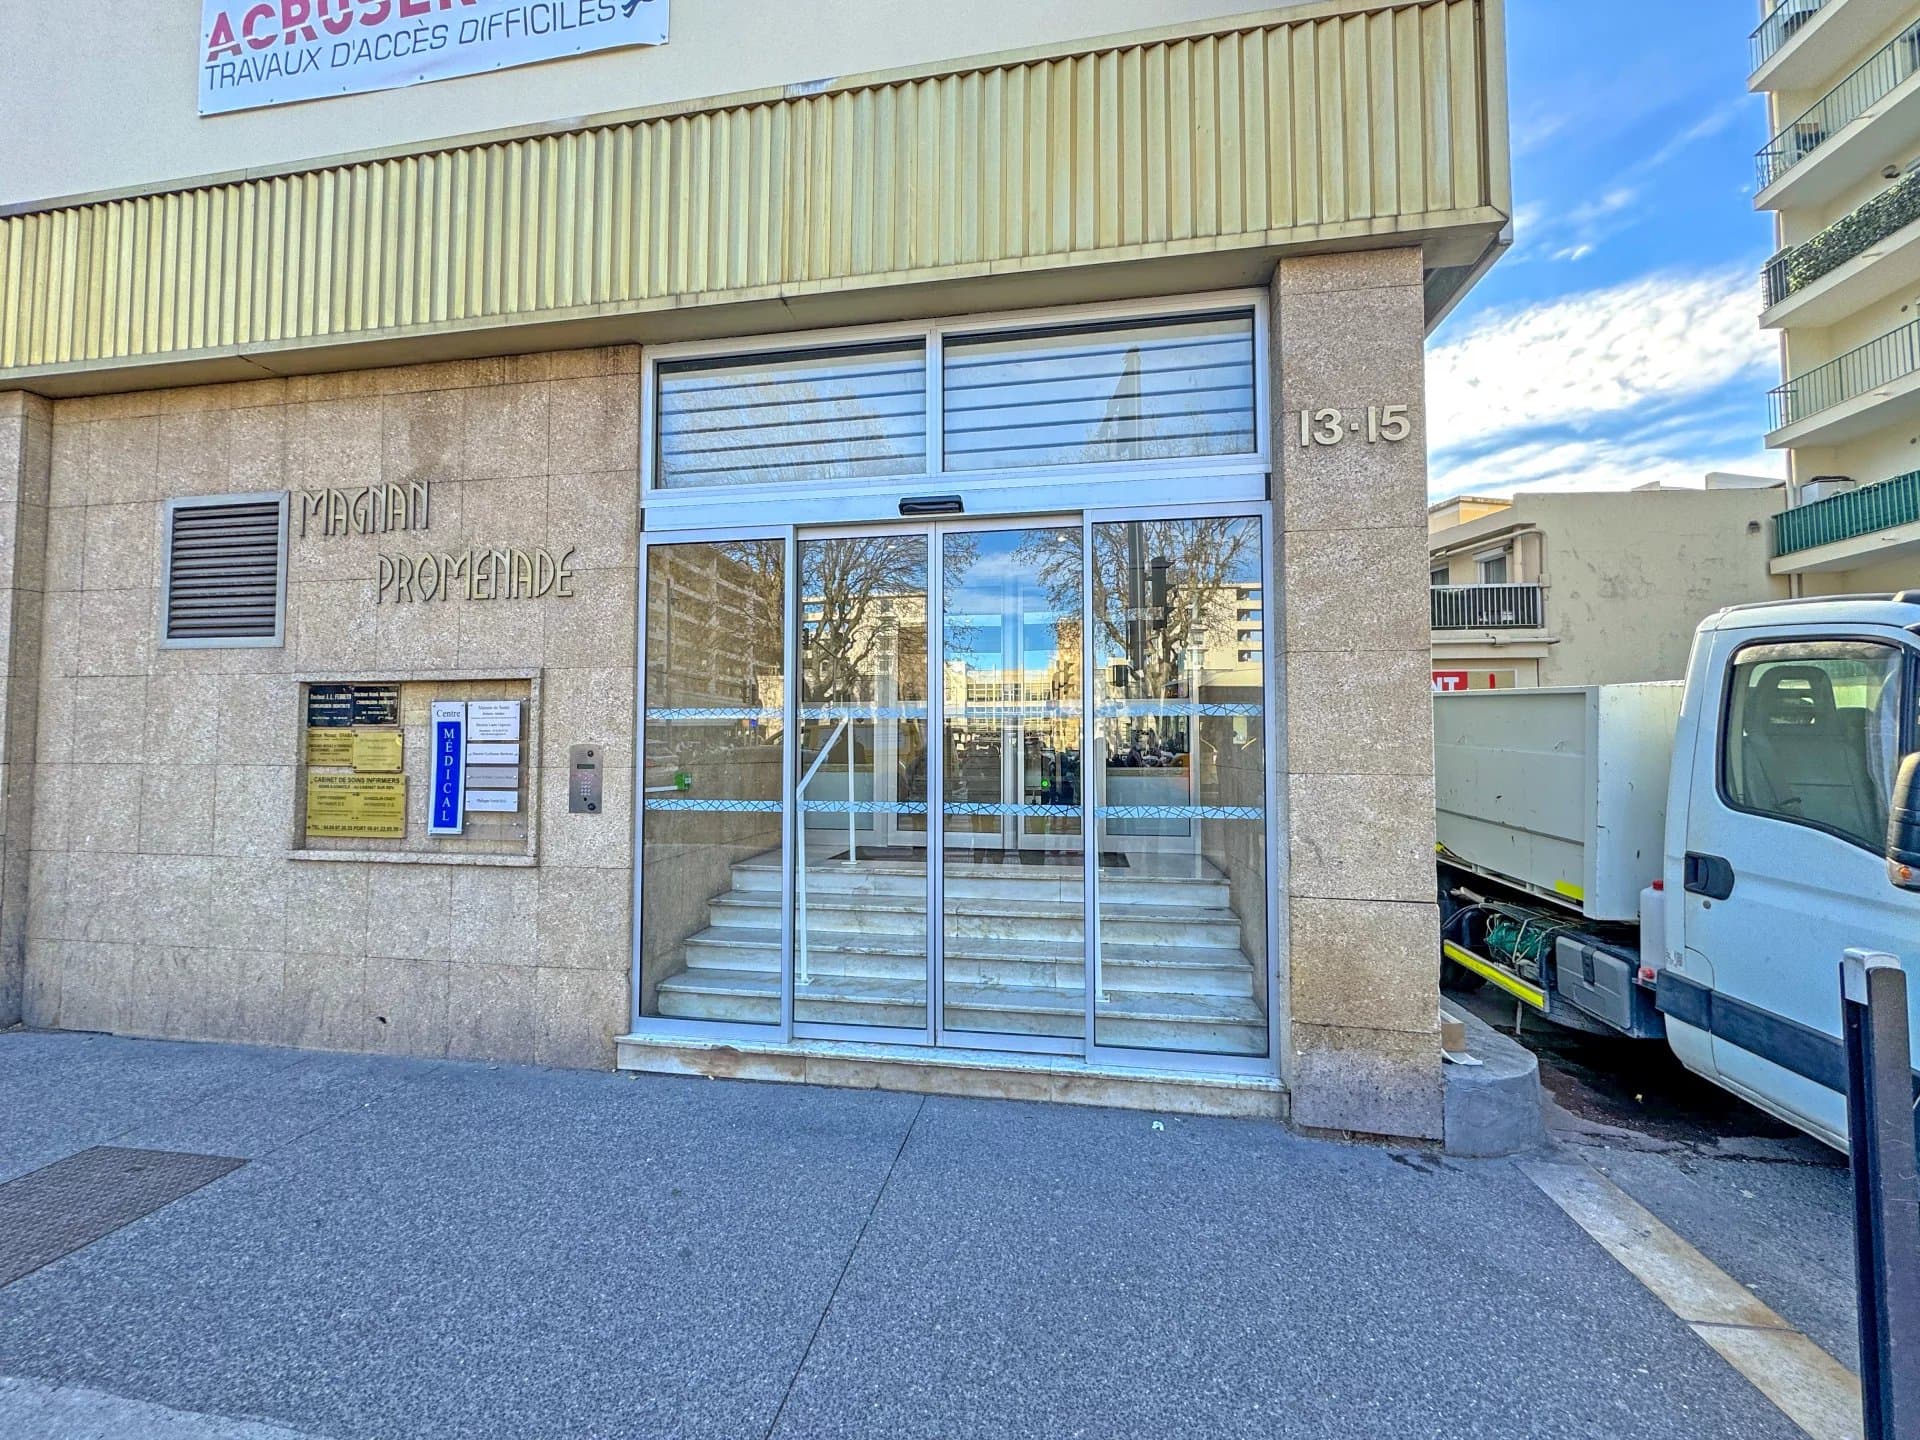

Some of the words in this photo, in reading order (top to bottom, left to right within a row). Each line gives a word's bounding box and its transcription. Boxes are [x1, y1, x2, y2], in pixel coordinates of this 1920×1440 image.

[205, 47, 322, 90] TRAVAUX
[331, 19, 449, 67] D'ACCÈS
[459, 0, 616, 44] DIFFICILES
[206, 0, 477, 63] ACROS
[300, 480, 430, 538] MAGNAN
[376, 545, 575, 604] PROMENADE
[436, 709, 461, 718] Centre
[441, 728, 455, 821] MÉDICAL
